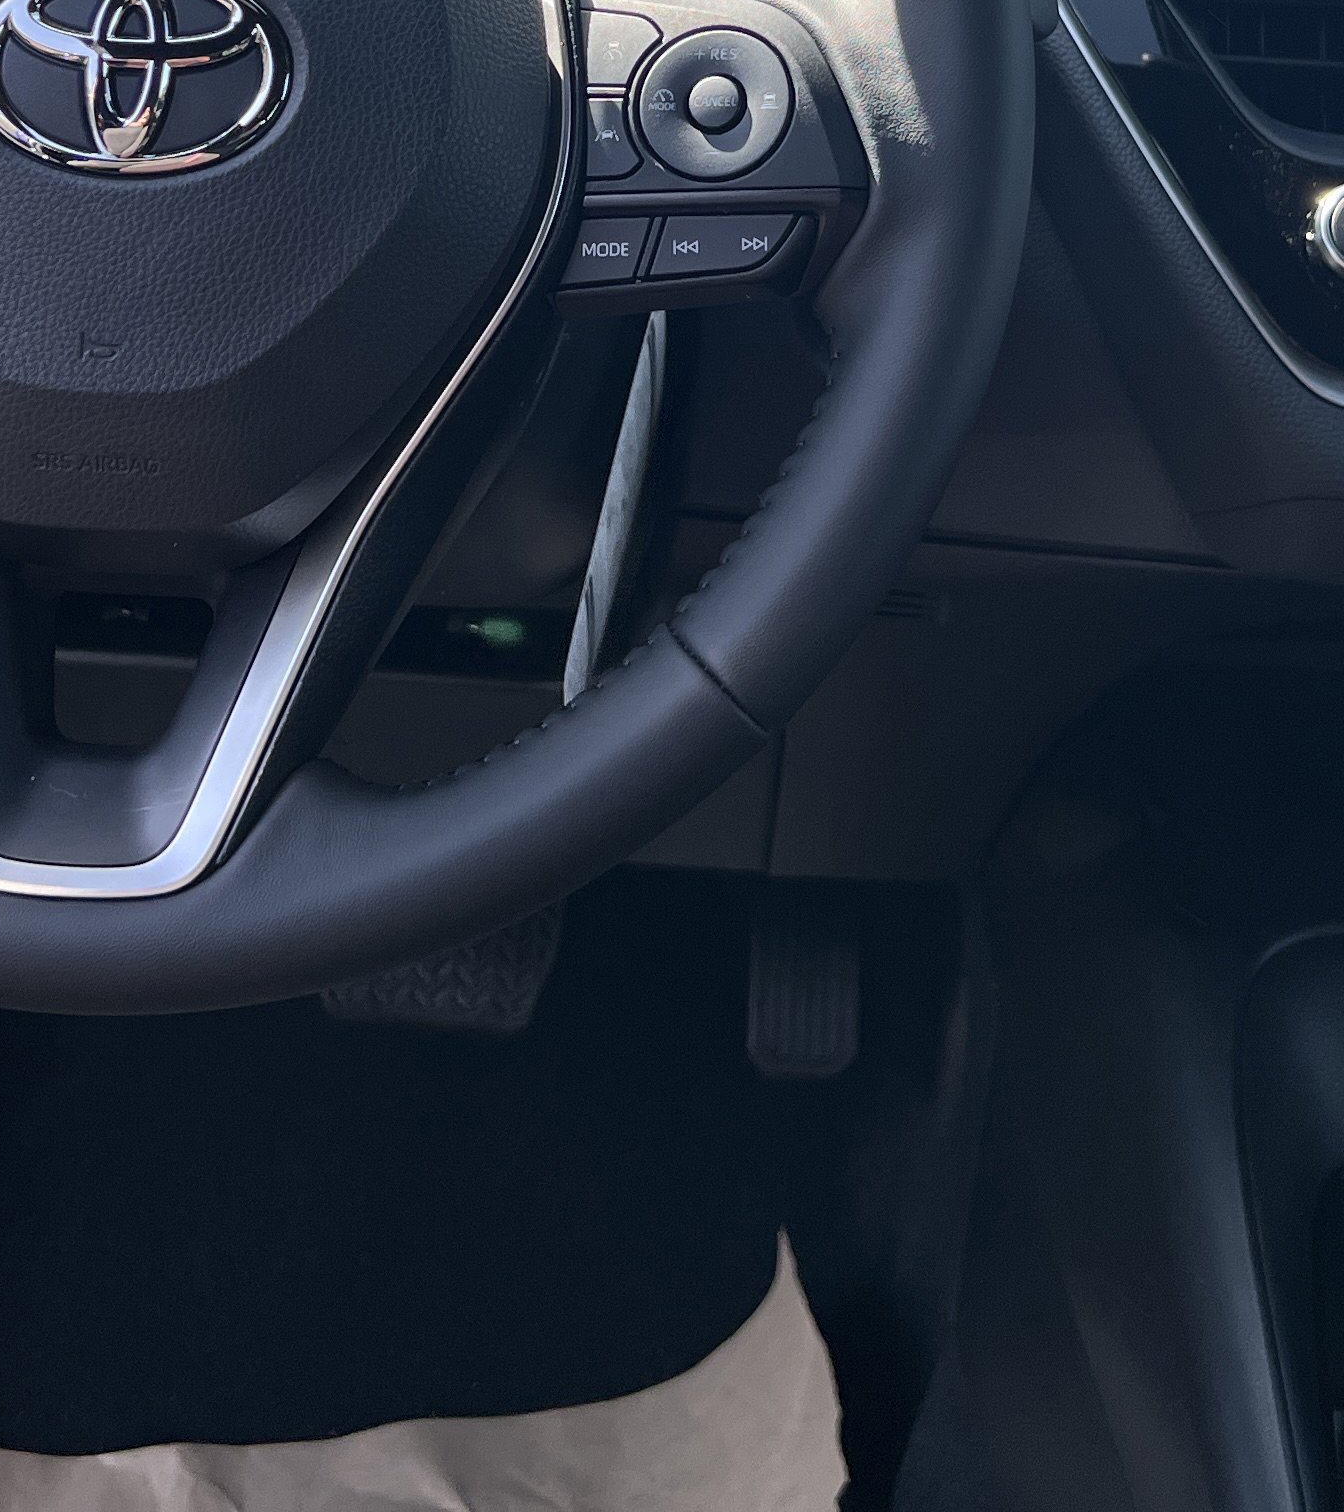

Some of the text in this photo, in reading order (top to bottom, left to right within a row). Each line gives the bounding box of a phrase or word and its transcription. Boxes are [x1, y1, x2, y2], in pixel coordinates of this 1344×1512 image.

[709, 47, 738, 61] RES
[648, 102, 676, 111] MODE
[693, 94, 737, 108] CANCEL
[582, 242, 630, 258] MODE
[32, 451, 162, 476] SRS AIRBAG
